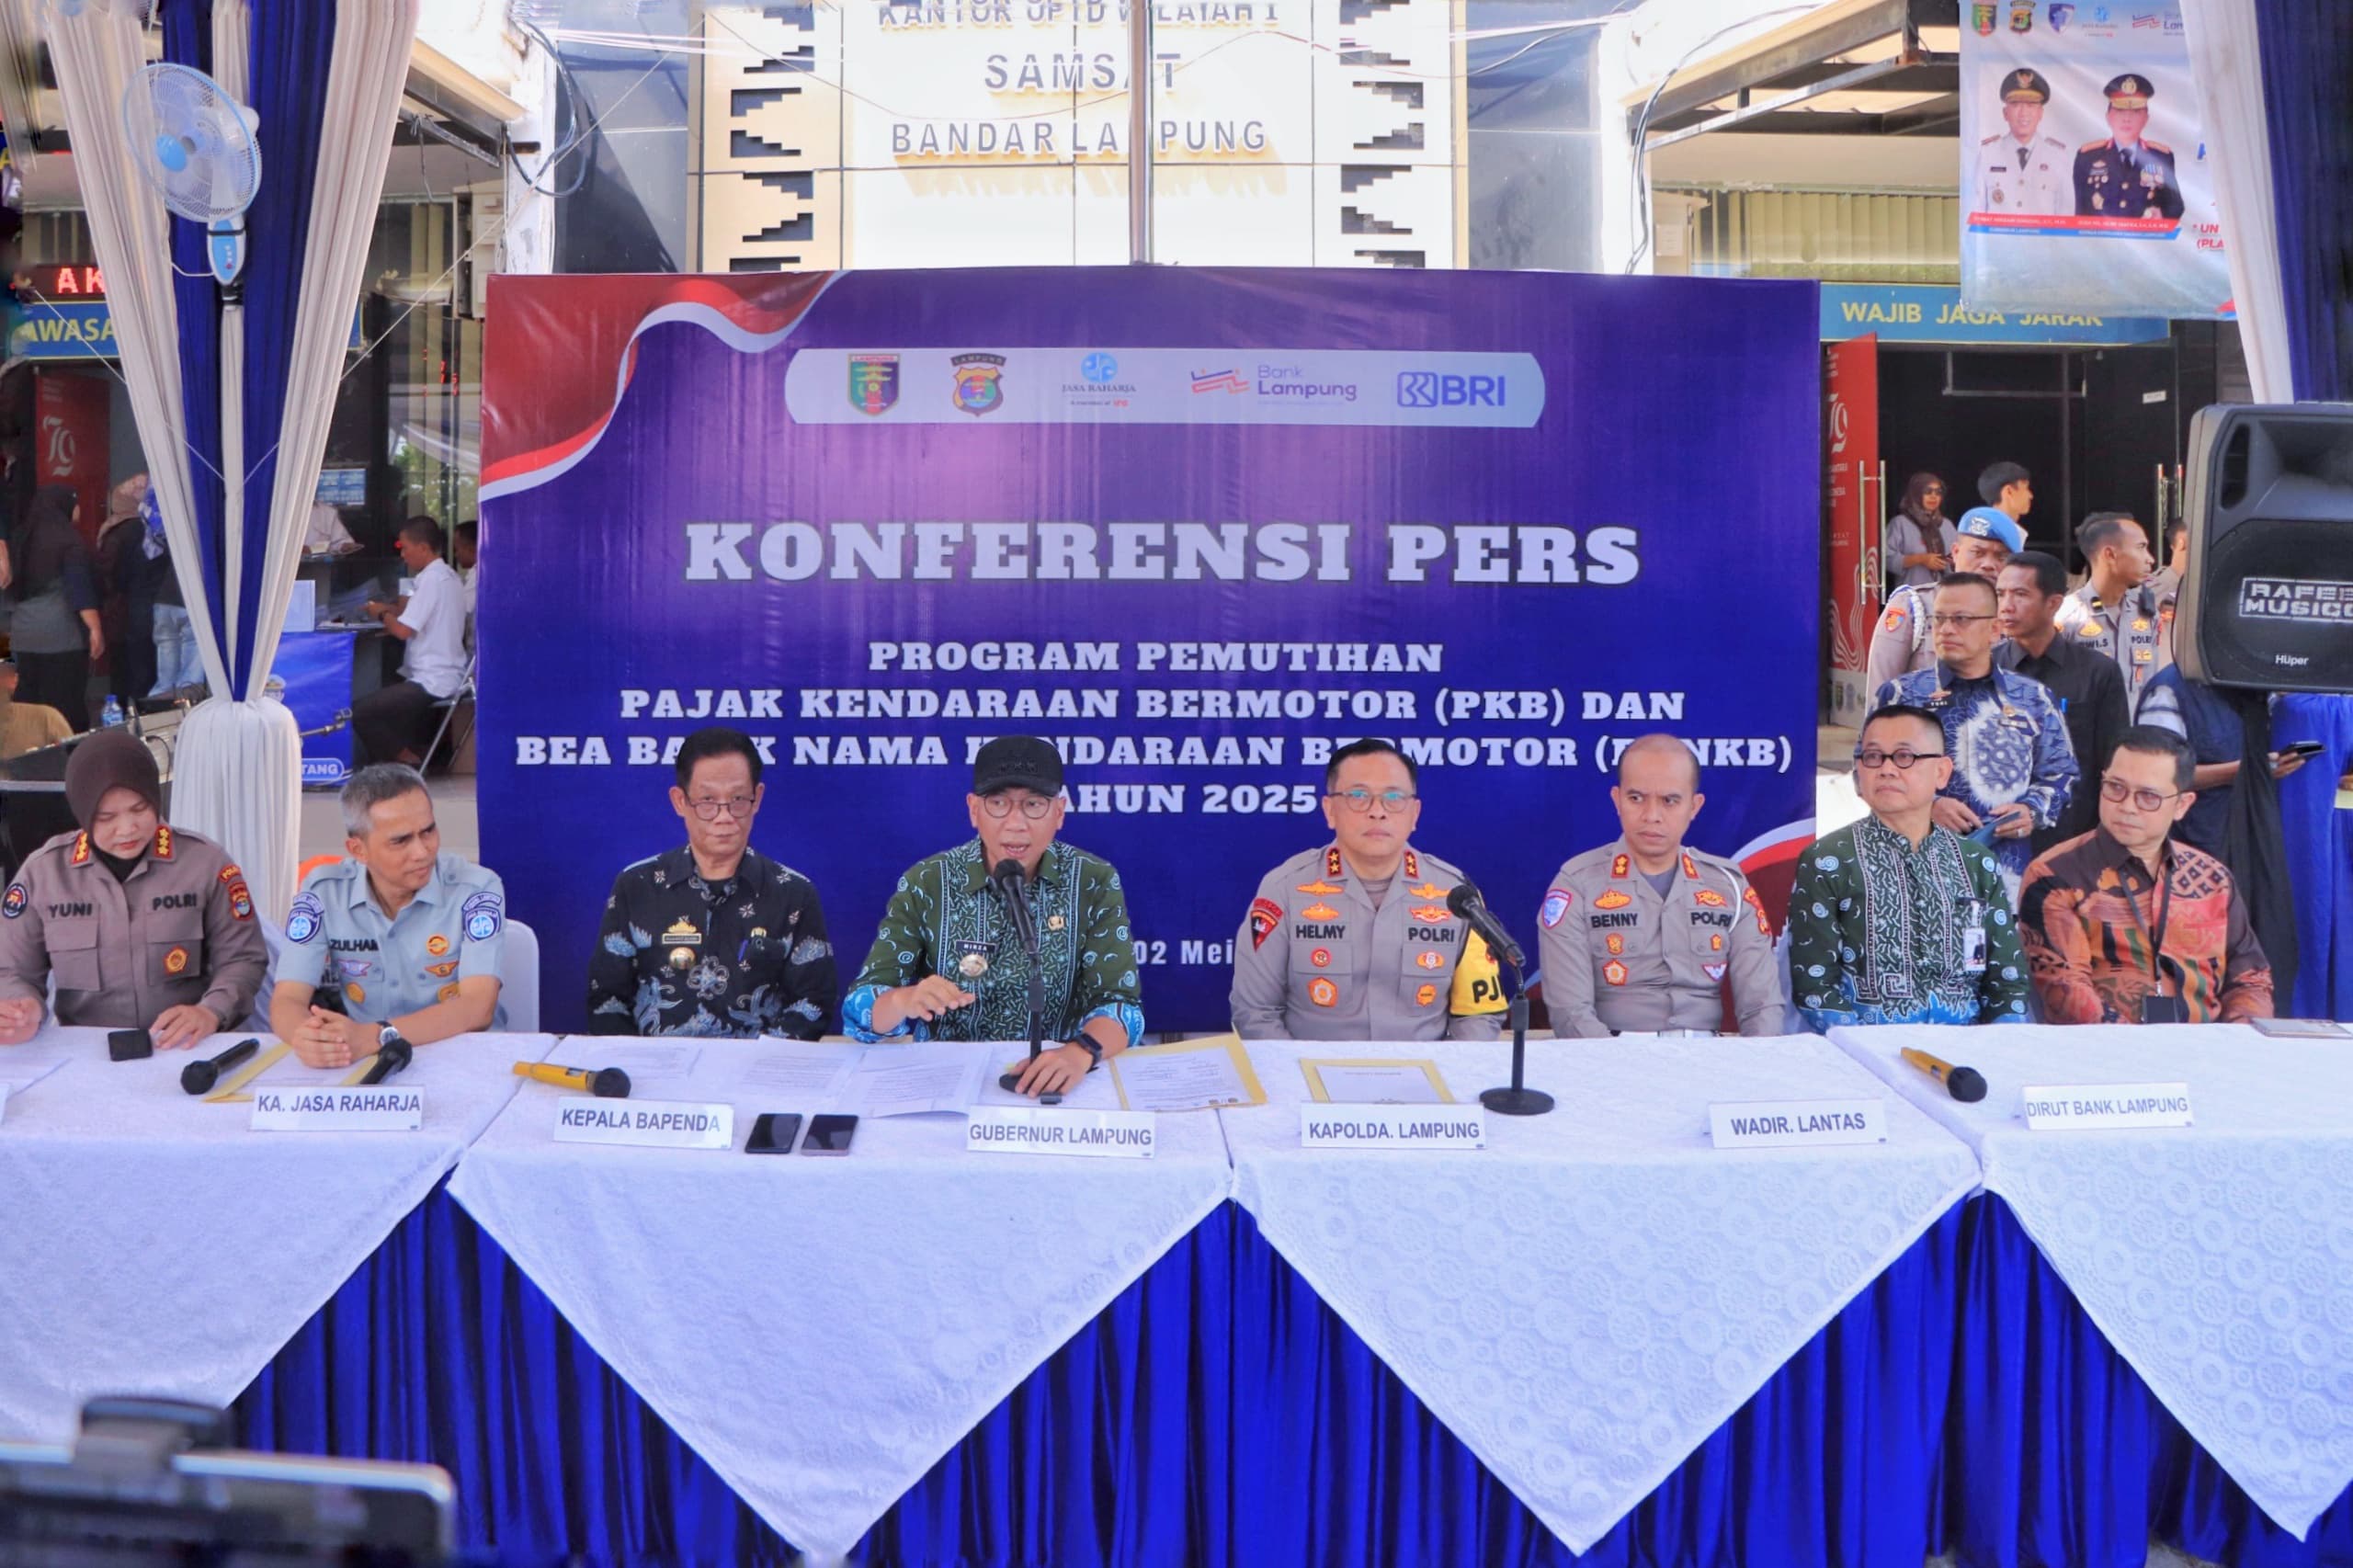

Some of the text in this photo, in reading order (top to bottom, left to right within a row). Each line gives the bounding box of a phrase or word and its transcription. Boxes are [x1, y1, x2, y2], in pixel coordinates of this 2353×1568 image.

[1119, 2, 1253, 22] LAYAH
[983, 52, 1182, 90] SAMST
[892, 120, 1266, 154] BANDAR LAPUNG
[1841, 301, 1923, 324] WAJIB
[1936, 303, 2006, 324] JAGA
[1257, 365, 1302, 379] Bank
[1257, 381, 1357, 401] Lampung
[1441, 375, 1505, 407] BRI
[685, 522, 1641, 585] KONFERENSI PERS
[869, 642, 1444, 673] PROGRAM PEMUTIHAN
[620, 687, 1686, 727] PAJAK KENDARAAN BERMOTOR (PKB) DAN
[517, 734, 1792, 774] BEA BAK NAMA KNDARAAN BMOTOR (NKB)
[1059, 784, 1317, 813] AHUN 2025
[48, 893, 198, 918] YUNI POLRI
[1591, 914, 1639, 928] BENNY
[1296, 925, 1455, 942] HELMY POLRI
[1133, 938, 1234, 965] 02 Mei
[258, 1095, 421, 1112] KA. JASA RAHARJA
[2027, 1096, 2188, 1117] DIRUT BANK LAMPUNG
[562, 1108, 721, 1132] KEPALA BAPENDA
[1309, 1122, 1480, 1139] KAPOLDA. LAMPUNG
[1731, 1112, 1866, 1136] WADIR. LANTAS
[970, 1124, 1153, 1145] GUBERNUR LAMPUNG
